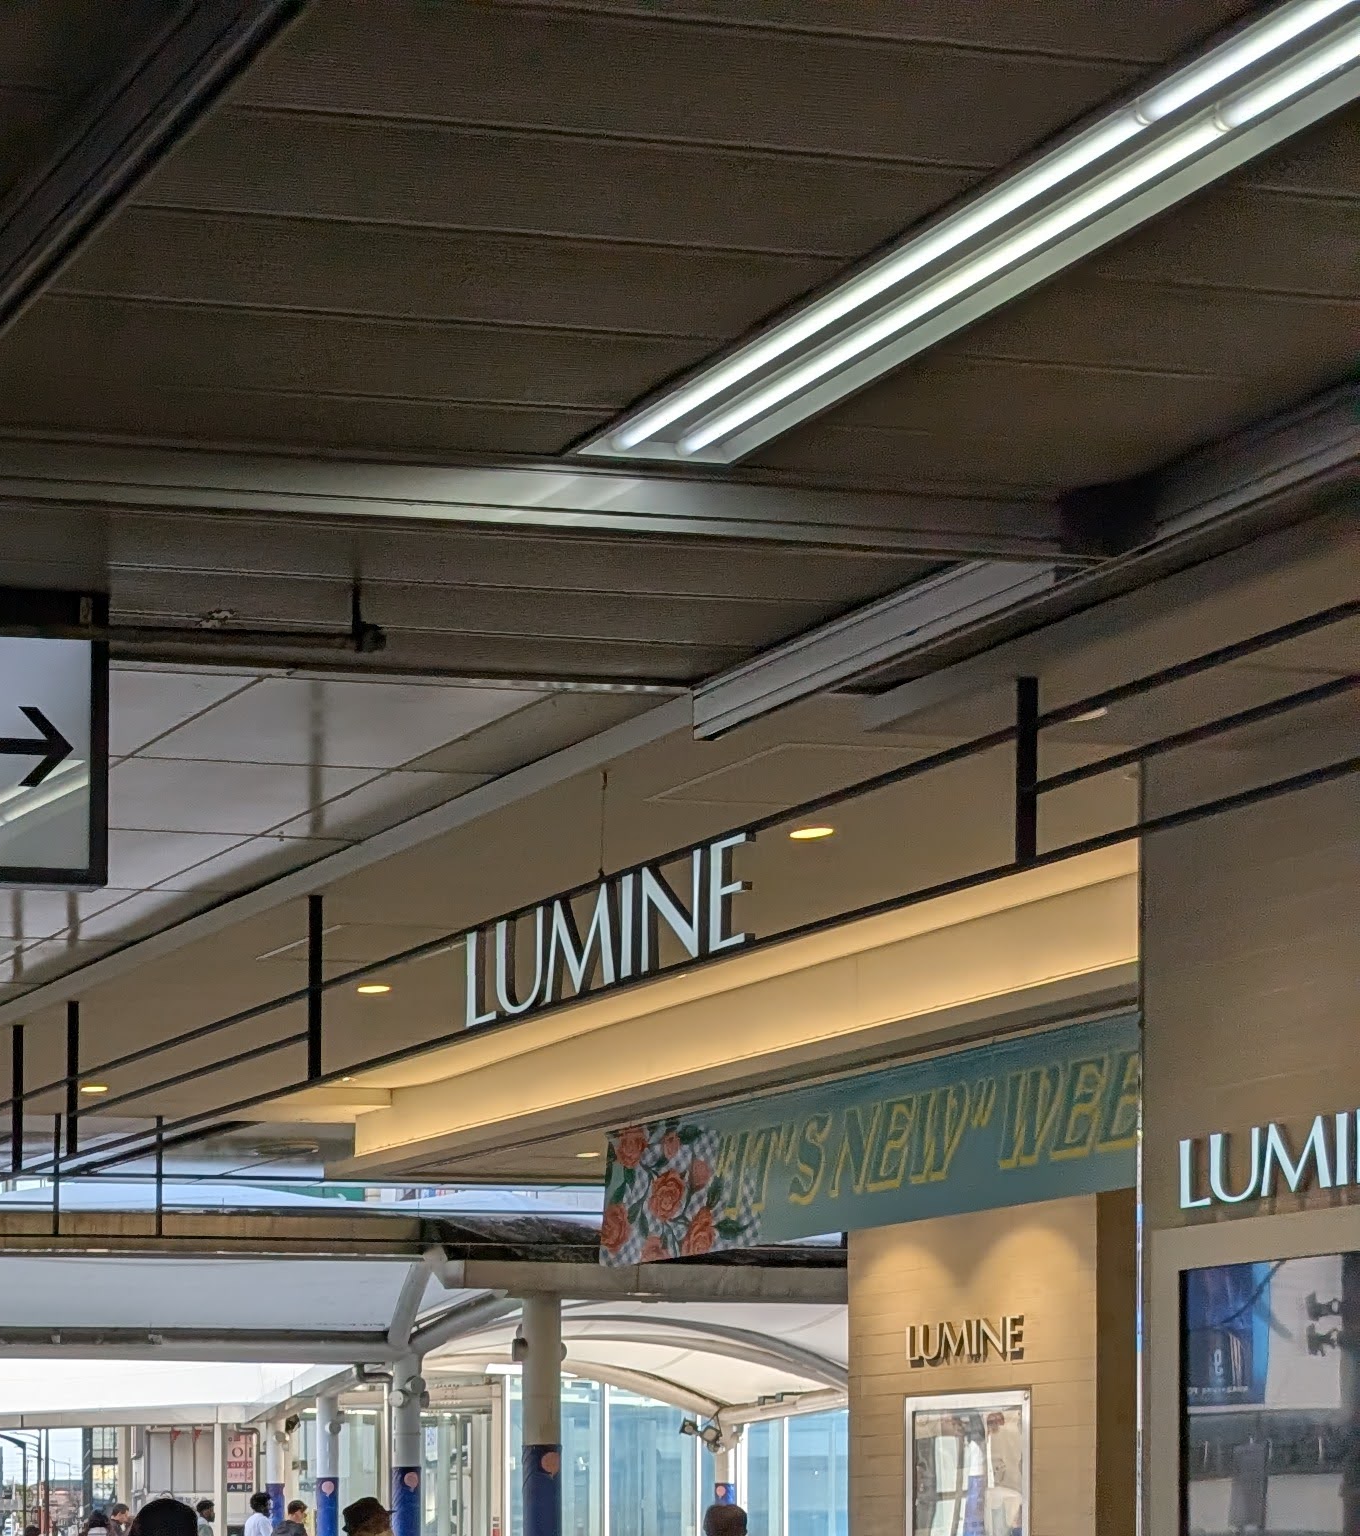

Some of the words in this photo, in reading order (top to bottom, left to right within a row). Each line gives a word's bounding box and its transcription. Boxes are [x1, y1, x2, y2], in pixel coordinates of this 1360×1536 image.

[464, 832, 757, 1028] LUMINE
[1179, 1108, 1360, 1210] LUMI
[905, 1314, 1025, 1367] LUMINE
